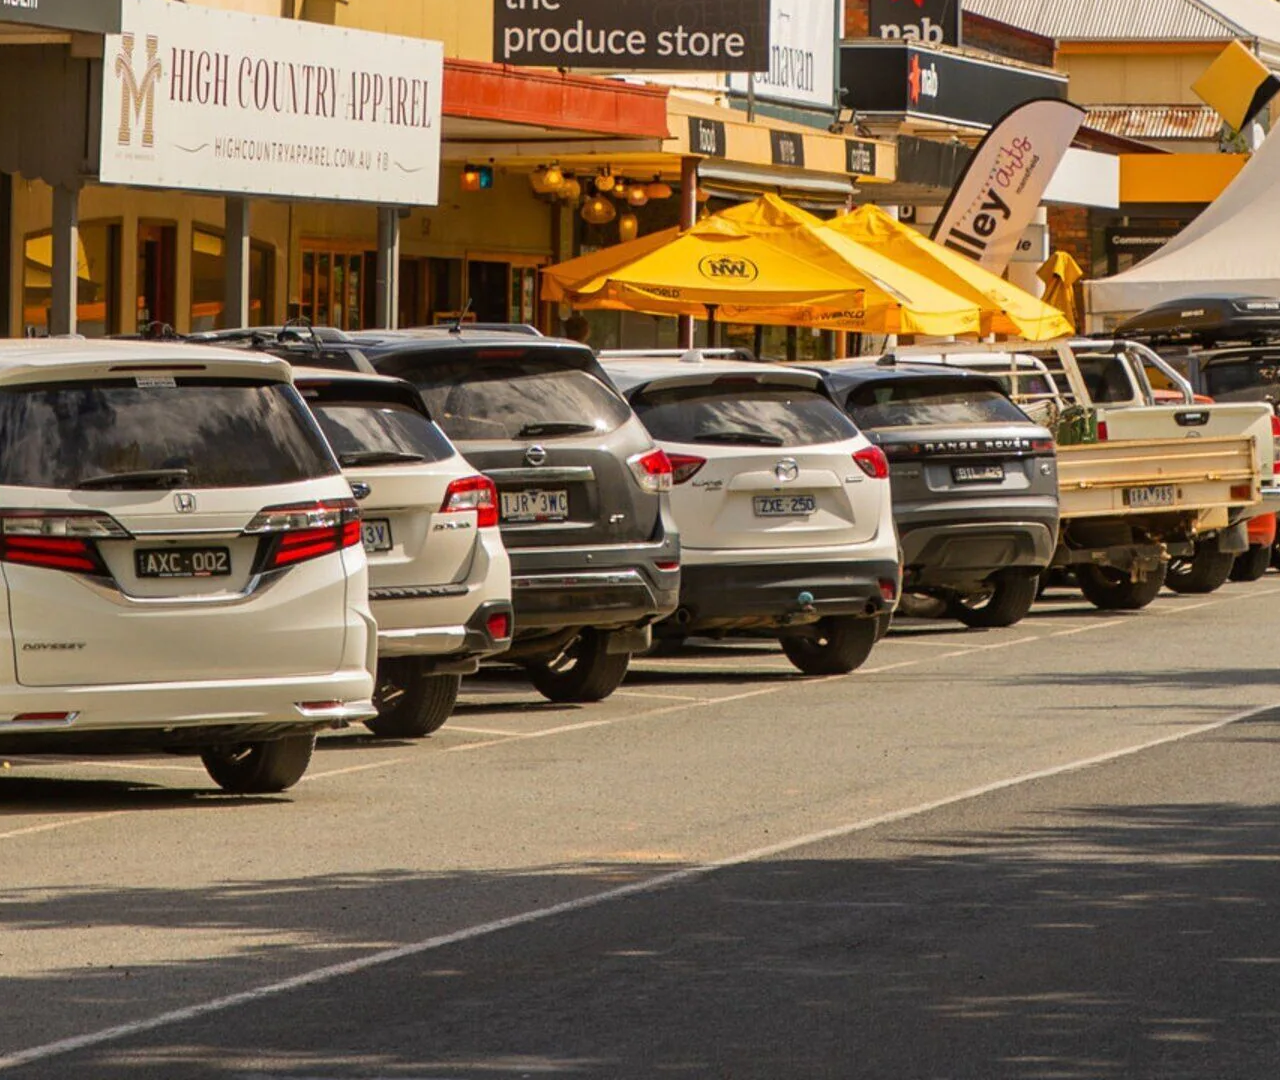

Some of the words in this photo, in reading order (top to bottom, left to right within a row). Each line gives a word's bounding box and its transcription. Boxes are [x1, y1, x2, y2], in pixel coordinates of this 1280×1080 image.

[503, 19, 646, 58] produce
[657, 24, 745, 57] store
[880, 17, 944, 45] nab
[170, 46, 230, 108] HIGH
[237, 55, 340, 119] COUNTRY
[344, 70, 432, 129] APPAREL
[215, 135, 371, 171] HIGHCOUNTRYAPPAREL.COM.AU
[996, 136, 1032, 188] arts
[943, 187, 1012, 262] lley
[924, 442, 978, 451] RANGE
[984, 439, 1029, 449] ROVER
